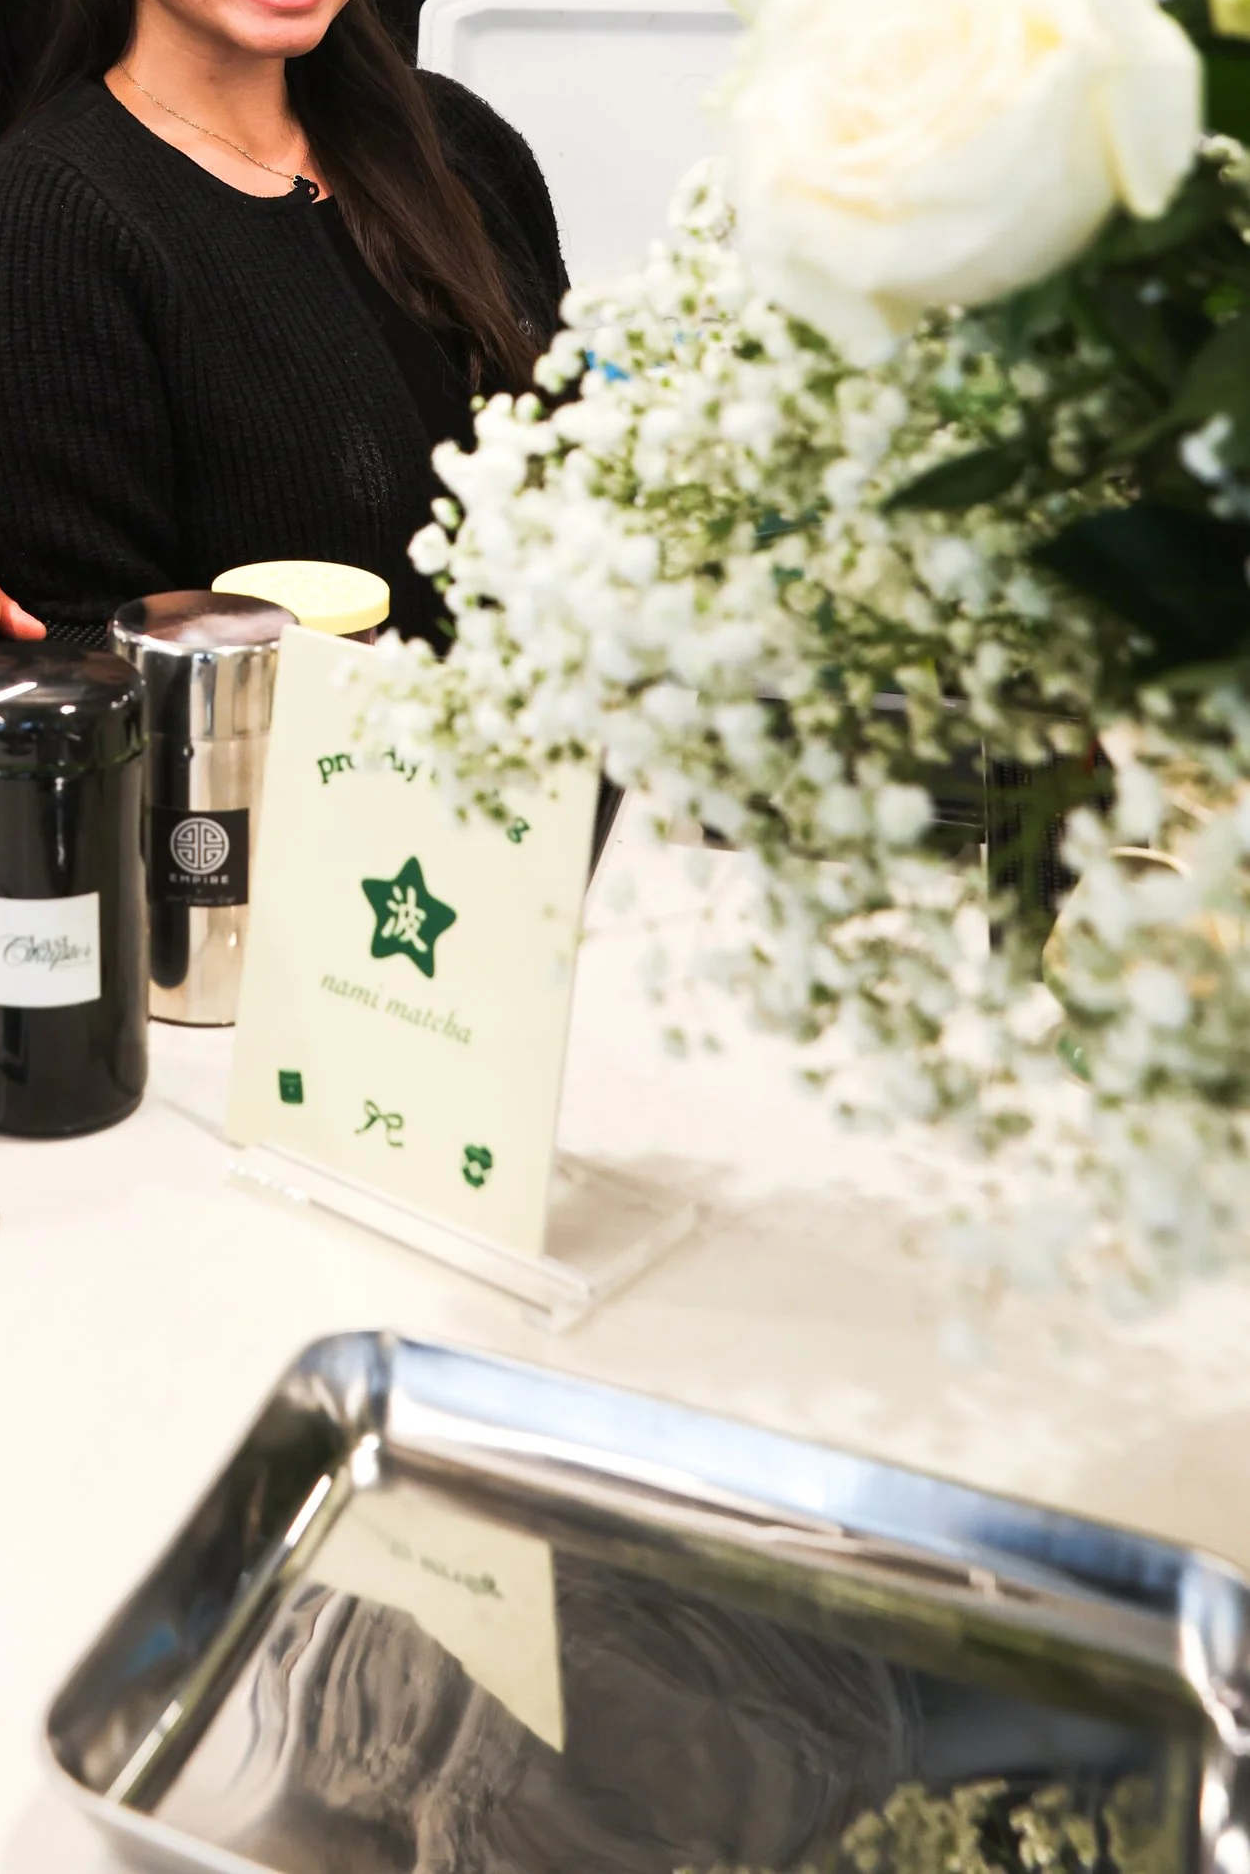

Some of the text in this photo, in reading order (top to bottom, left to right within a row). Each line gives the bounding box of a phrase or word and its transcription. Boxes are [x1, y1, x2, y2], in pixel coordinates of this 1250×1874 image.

[168, 873, 230, 884] EMPIRE
[380, 884, 429, 954] 波
[320, 973, 473, 1046] nami matcha
